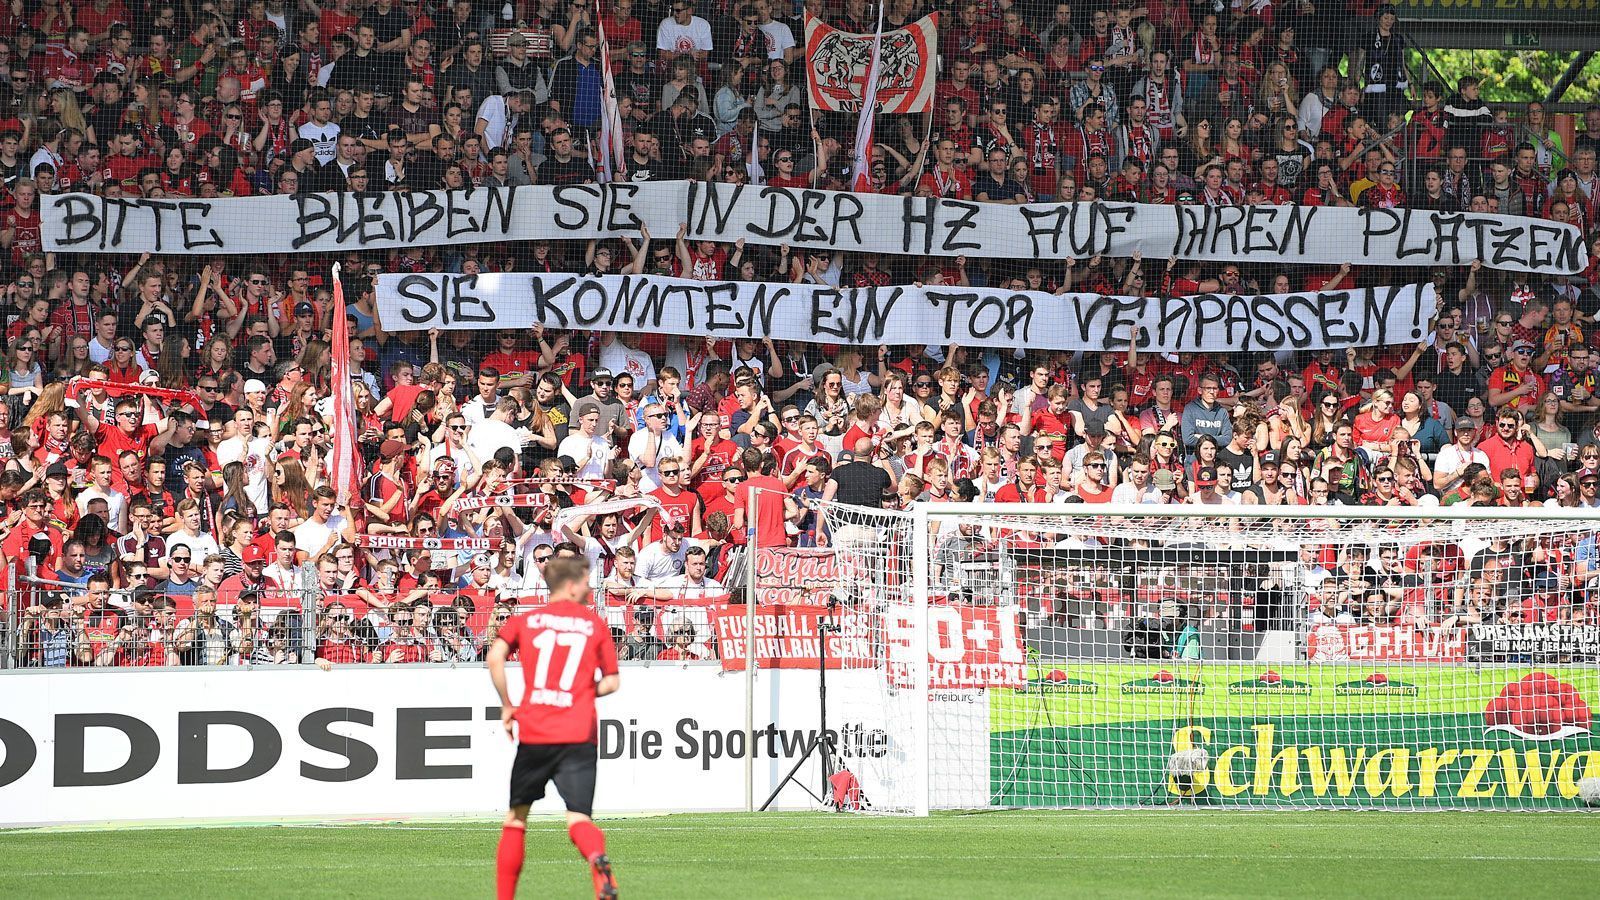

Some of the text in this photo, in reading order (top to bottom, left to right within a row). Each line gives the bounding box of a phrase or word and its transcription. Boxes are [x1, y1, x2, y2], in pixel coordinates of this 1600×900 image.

[53, 181, 1586, 271] BITTE BLEIBEN SIE IN DER HZ AUF IHREN PLÄTZEN
[397, 275, 496, 325] SIE
[811, 286, 904, 343] EIN
[925, 291, 1034, 343] TOR
[368, 536, 492, 550] SPORT CLUB
[718, 614, 813, 638] FUSBALL
[1494, 640, 1509, 651] EIN
[1513, 640, 1540, 651] NAME
[532, 629, 588, 692] 17
[0, 707, 889, 787] DDSE Die Sportwette
